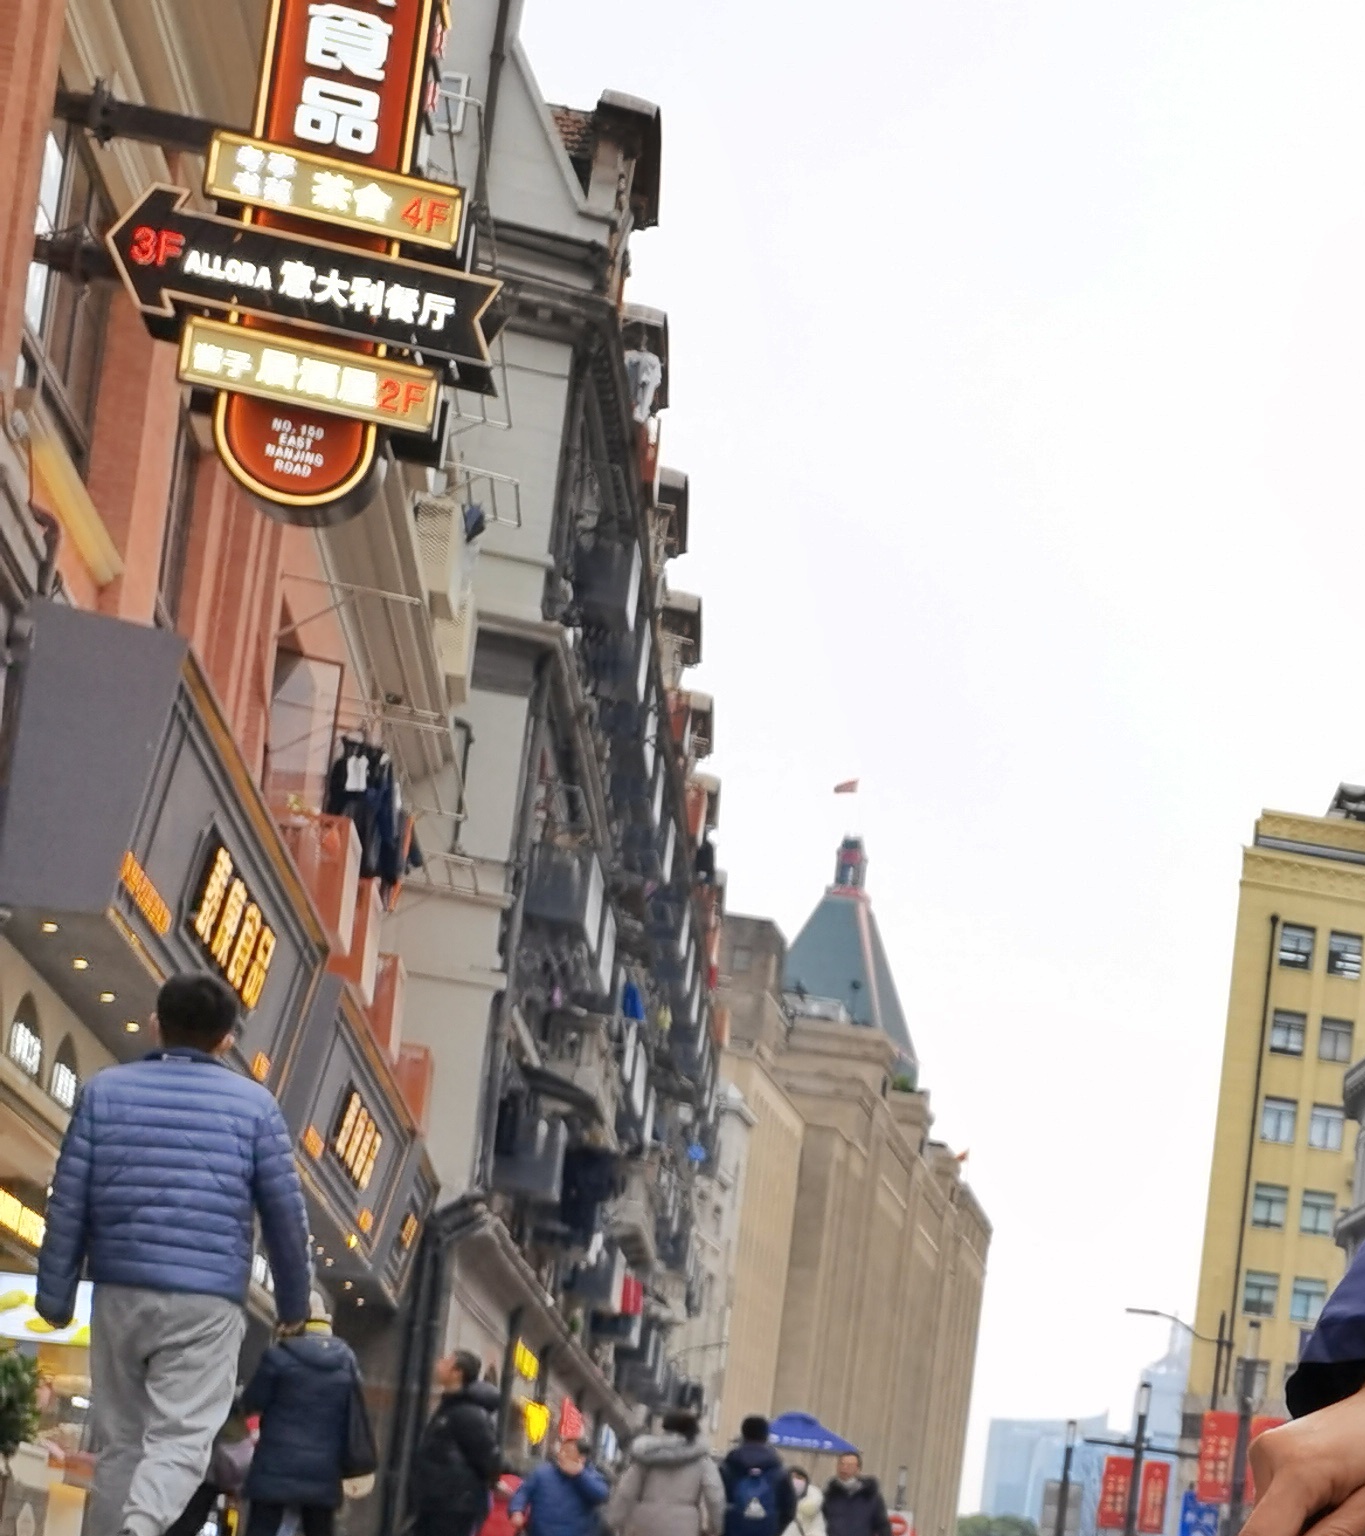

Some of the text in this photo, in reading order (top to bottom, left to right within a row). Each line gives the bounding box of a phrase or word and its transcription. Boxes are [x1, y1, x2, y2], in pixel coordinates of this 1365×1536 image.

[401, 196, 450, 233] 4F
[129, 225, 456, 332] 3F ALLORA 意大利餐厅
[378, 378, 428, 413] 2F
[264, 442, 324, 468] NANJING
[278, 432, 314, 451] EAST
[273, 458, 312, 478] ROAD
